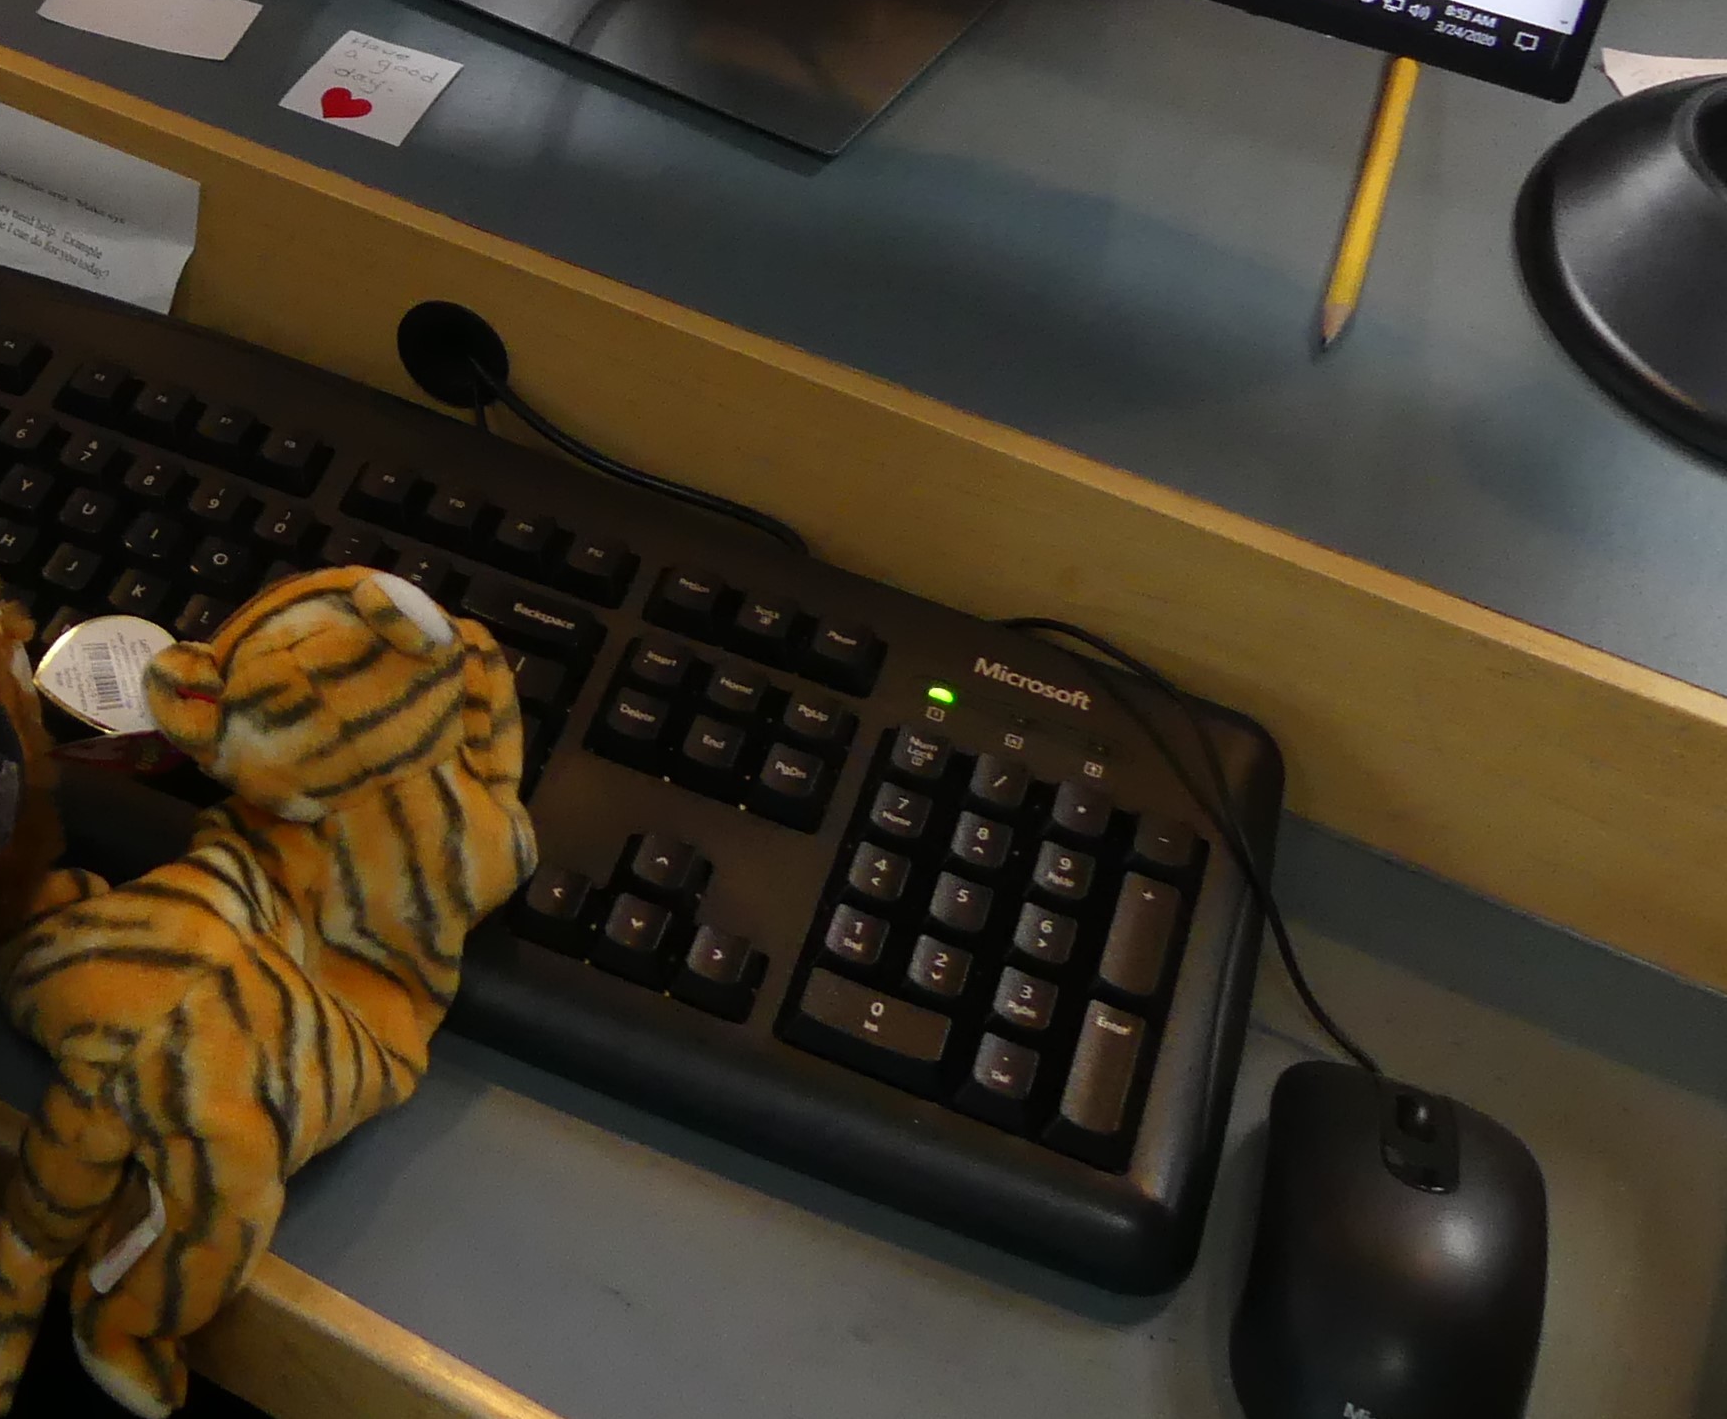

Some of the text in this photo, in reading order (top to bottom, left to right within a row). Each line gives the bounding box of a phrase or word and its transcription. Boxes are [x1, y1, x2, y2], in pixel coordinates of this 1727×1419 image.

[351, 38, 410, 59] Have
[369, 60, 439, 83] good
[513, 602, 575, 630] Backspace
[720, 677, 754, 695] Home
[973, 657, 1092, 711] Microsoft
[701, 734, 725, 749] End
[897, 796, 910, 810] 7
[976, 827, 990, 841] 8
[874, 859, 888, 873] 4
[1059, 856, 1072, 871] 9
[957, 889, 969, 903] 5
[853, 921, 864, 935] 1
[1040, 920, 1053, 934] 6
[935, 952, 949, 967] 2
[1020, 985, 1032, 999] 3
[870, 1002, 884, 1016] 0
